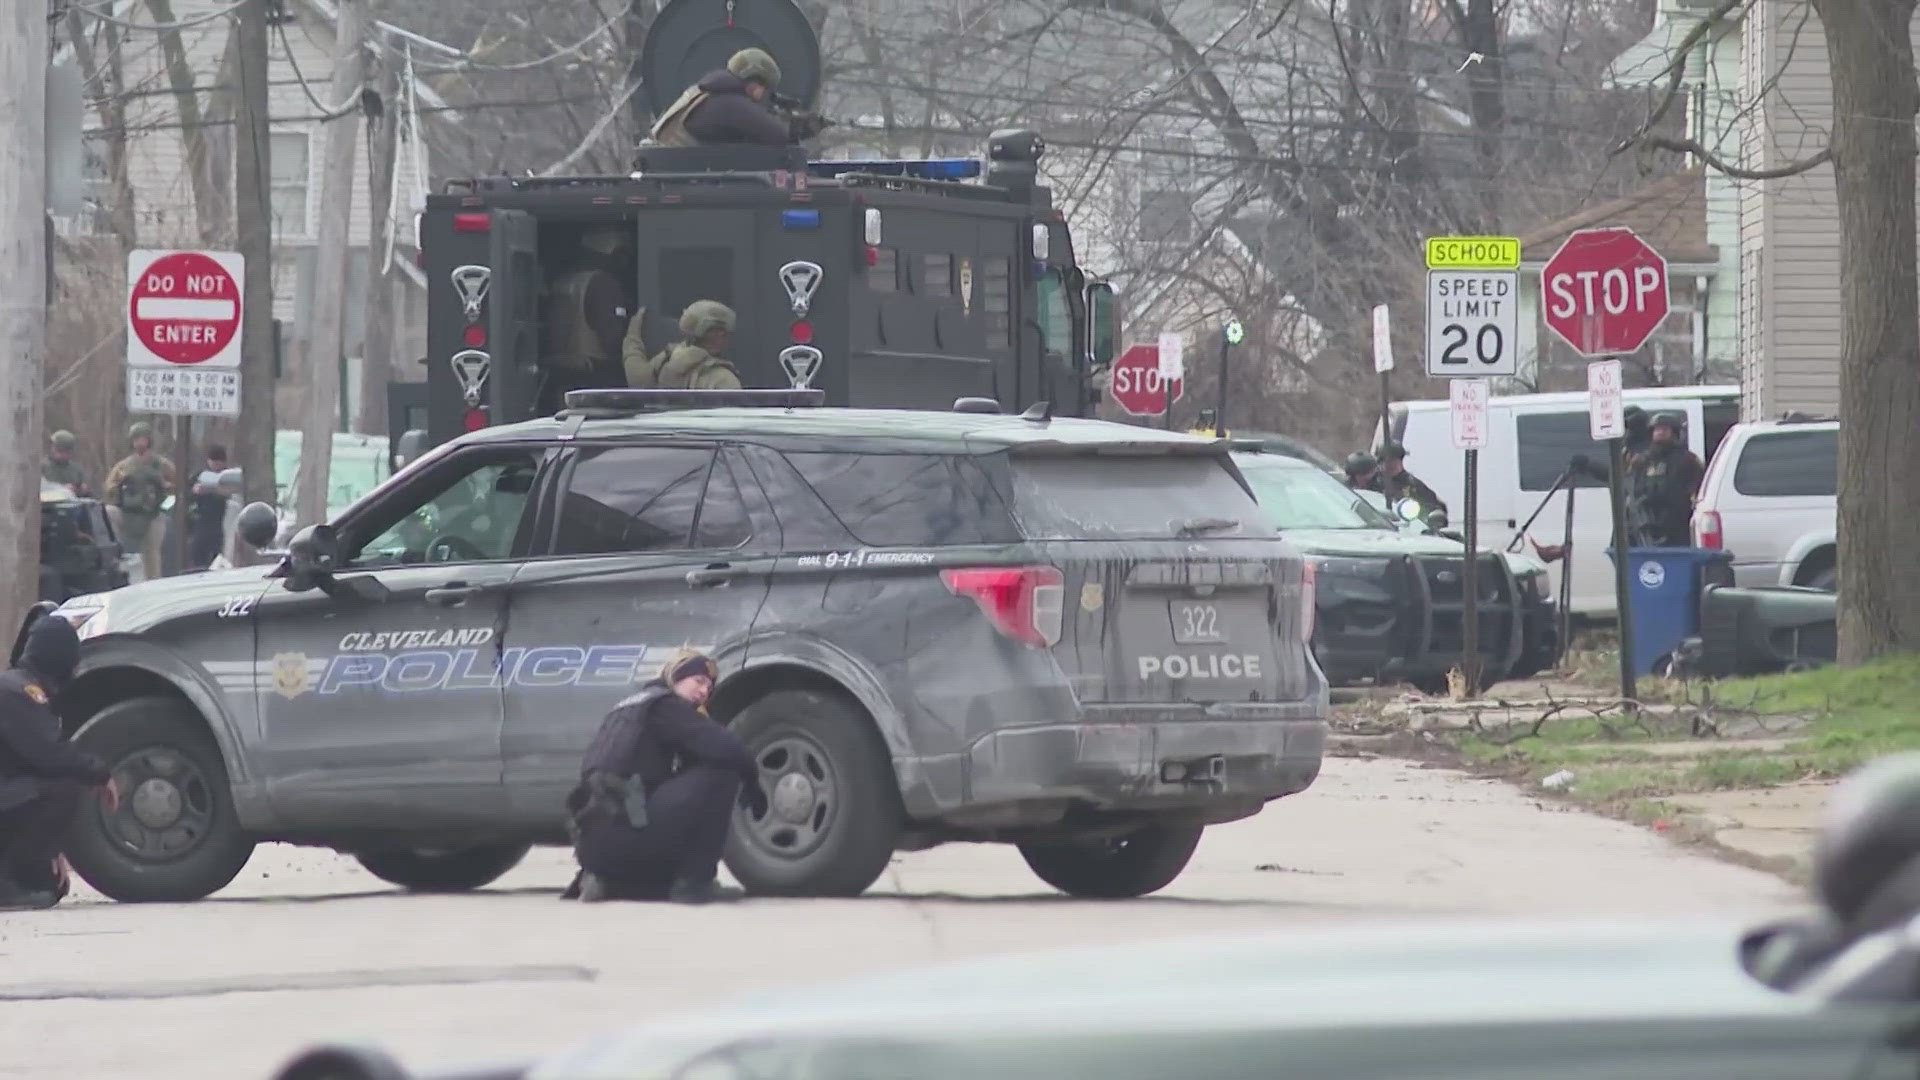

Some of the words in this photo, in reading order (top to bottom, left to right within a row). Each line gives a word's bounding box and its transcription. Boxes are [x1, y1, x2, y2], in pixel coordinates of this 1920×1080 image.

[1435, 243, 1511, 262] SCHOOL
[147, 274, 175, 293] DO
[186, 275, 226, 294] NOT
[1438, 278, 1509, 297] SPEED
[1551, 266, 1660, 319] STOP
[1443, 300, 1501, 318] LIMIT
[153, 325, 217, 344] ENTER
[1441, 323, 1503, 365] 20
[824, 551, 866, 568] 9-1-1
[866, 552, 936, 564] EMERGENCY
[218, 597, 252, 618] 322
[1182, 605, 1221, 639] 322
[338, 627, 494, 651] CLEVELAND
[320, 645, 646, 694] POLICE
[1137, 654, 1262, 680] POLICE
